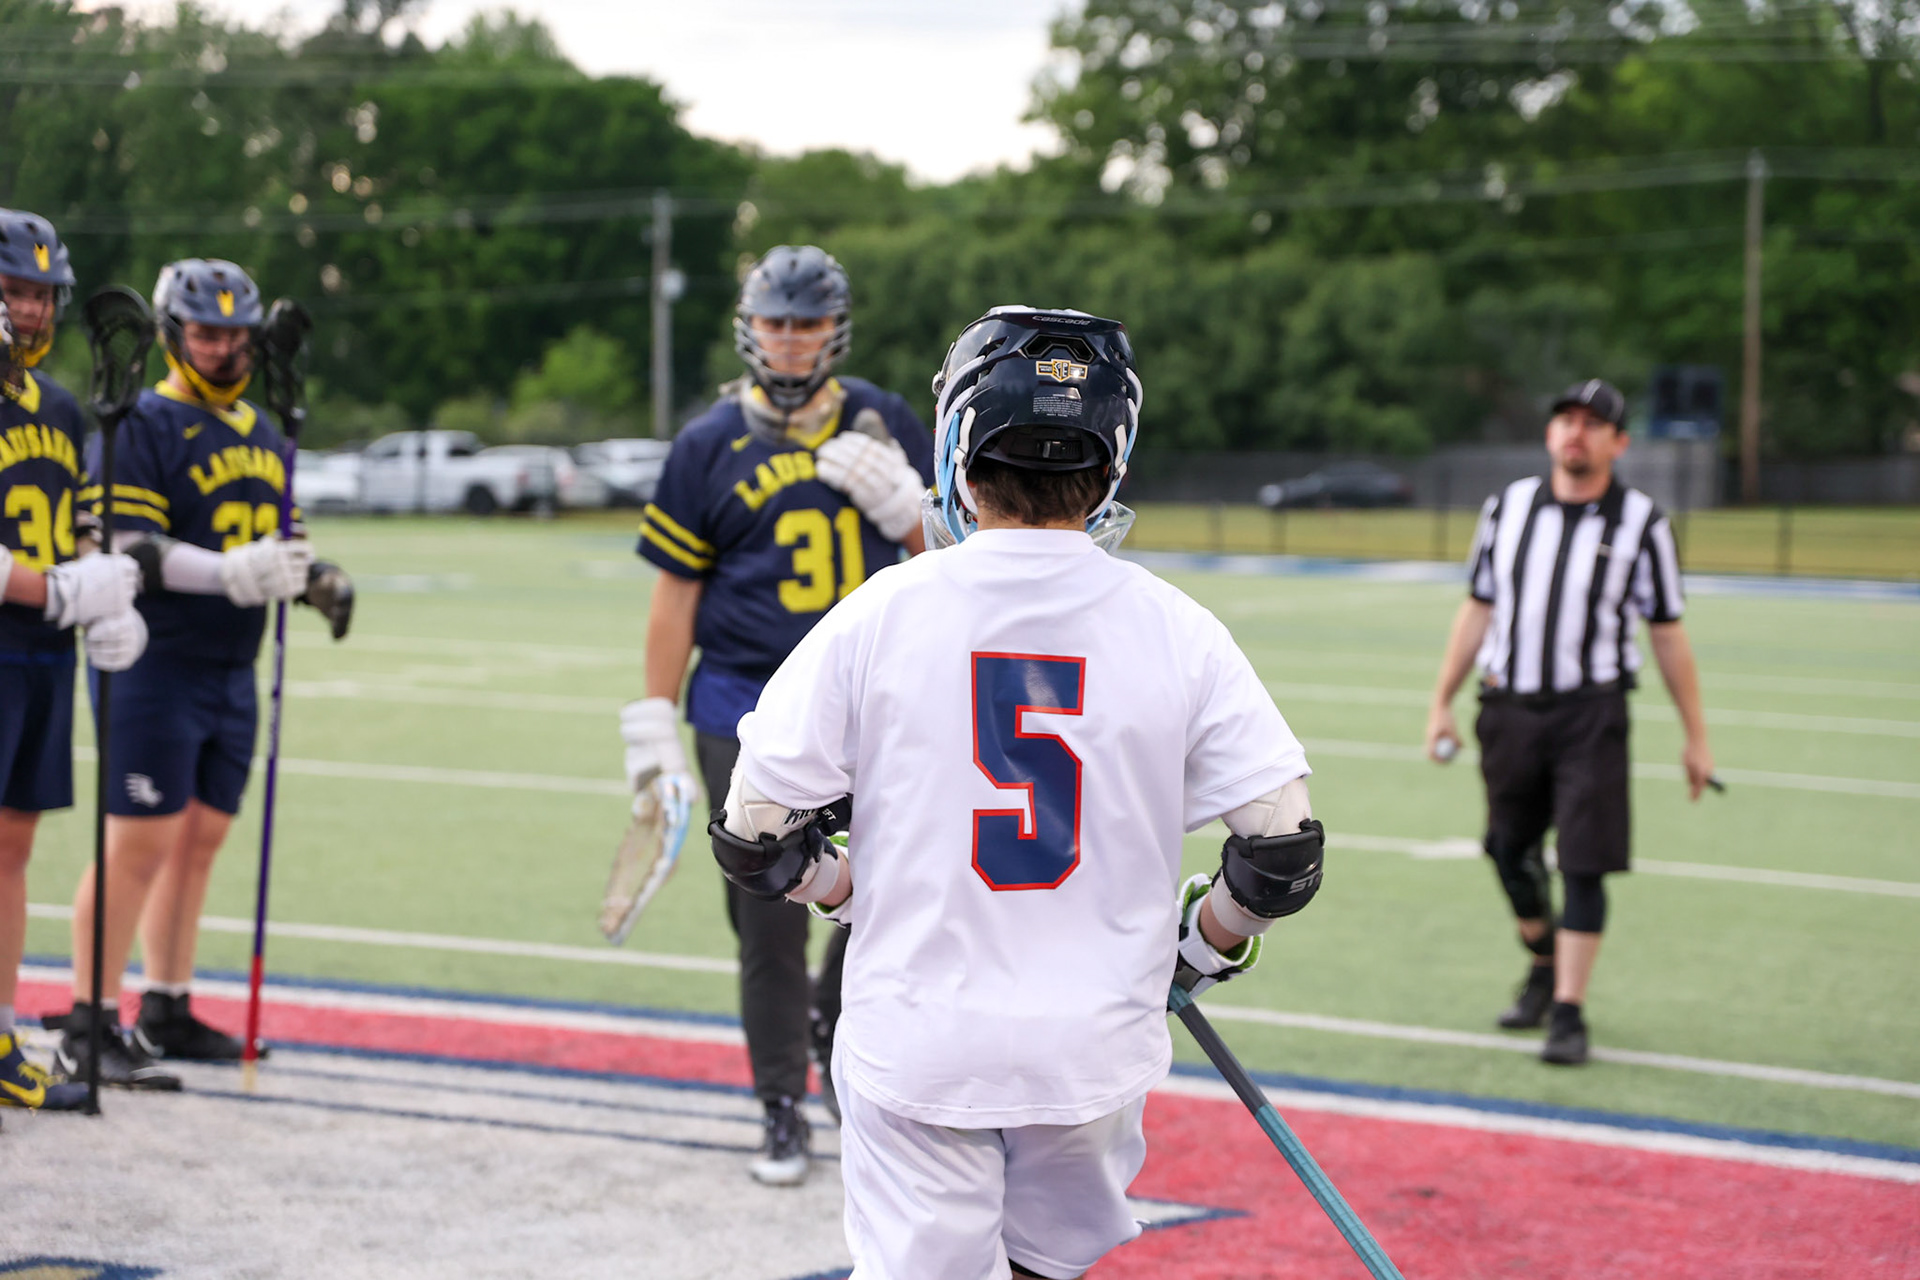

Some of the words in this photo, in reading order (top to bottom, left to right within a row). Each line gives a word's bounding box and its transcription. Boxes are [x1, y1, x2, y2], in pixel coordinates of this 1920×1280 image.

[1032, 315, 1091, 326] cascade
[774, 506, 866, 614] 31
[971, 651, 1086, 891] 5
[1287, 870, 1321, 895] ST
